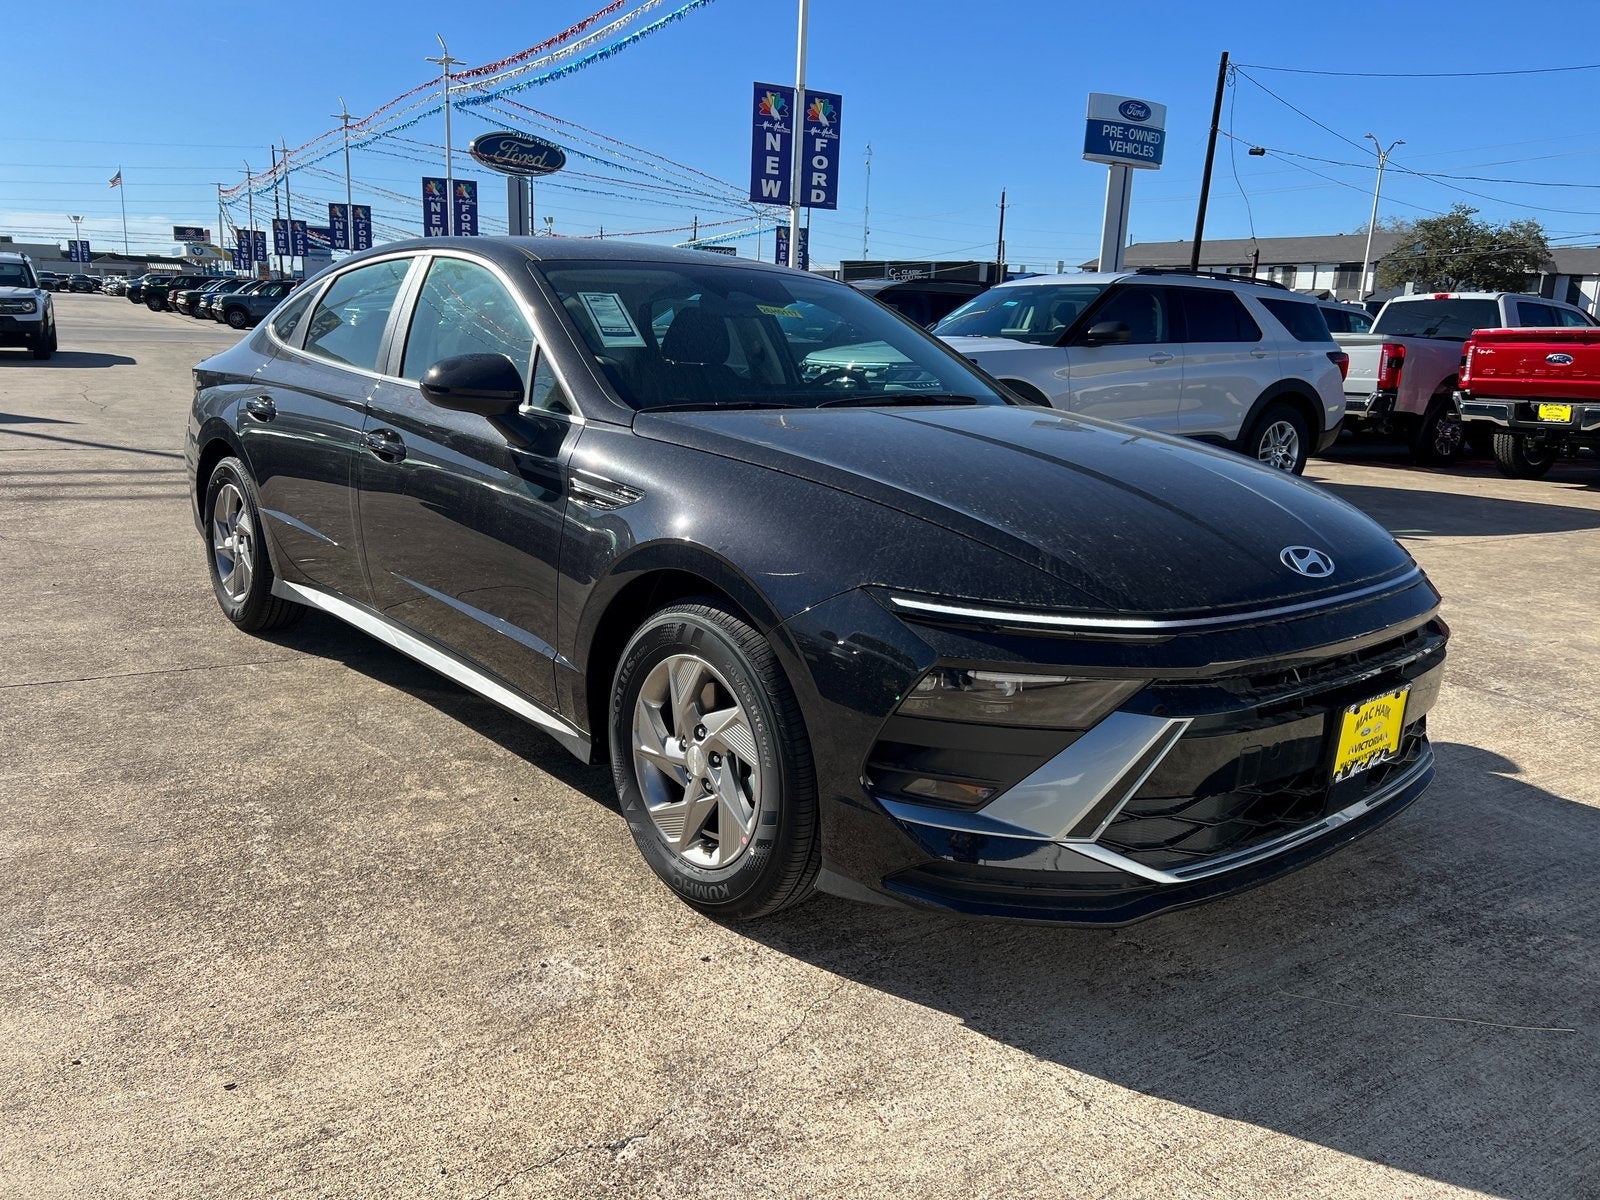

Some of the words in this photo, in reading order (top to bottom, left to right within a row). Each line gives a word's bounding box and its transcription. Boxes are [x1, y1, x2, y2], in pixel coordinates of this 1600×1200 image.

[1102, 124, 1160, 144] PRE-OWNED
[494, 139, 549, 168] Ford
[1109, 140, 1154, 158] VEHICLES
[761, 131, 782, 198] NEW
[810, 138, 829, 203] FORD
[430, 202, 443, 237] NEW
[460, 204, 471, 237] FORD
[278, 233, 287, 254] NEW
[335, 221, 345, 248] NEW
[358, 223, 367, 249] FORD
[241, 241, 249, 259] NEW
[611, 657, 635, 728] SOLUS
[1354, 706, 1375, 733] MAC
[1354, 734, 1386, 754] VICTORIA
[672, 874, 730, 900] KUMHO
